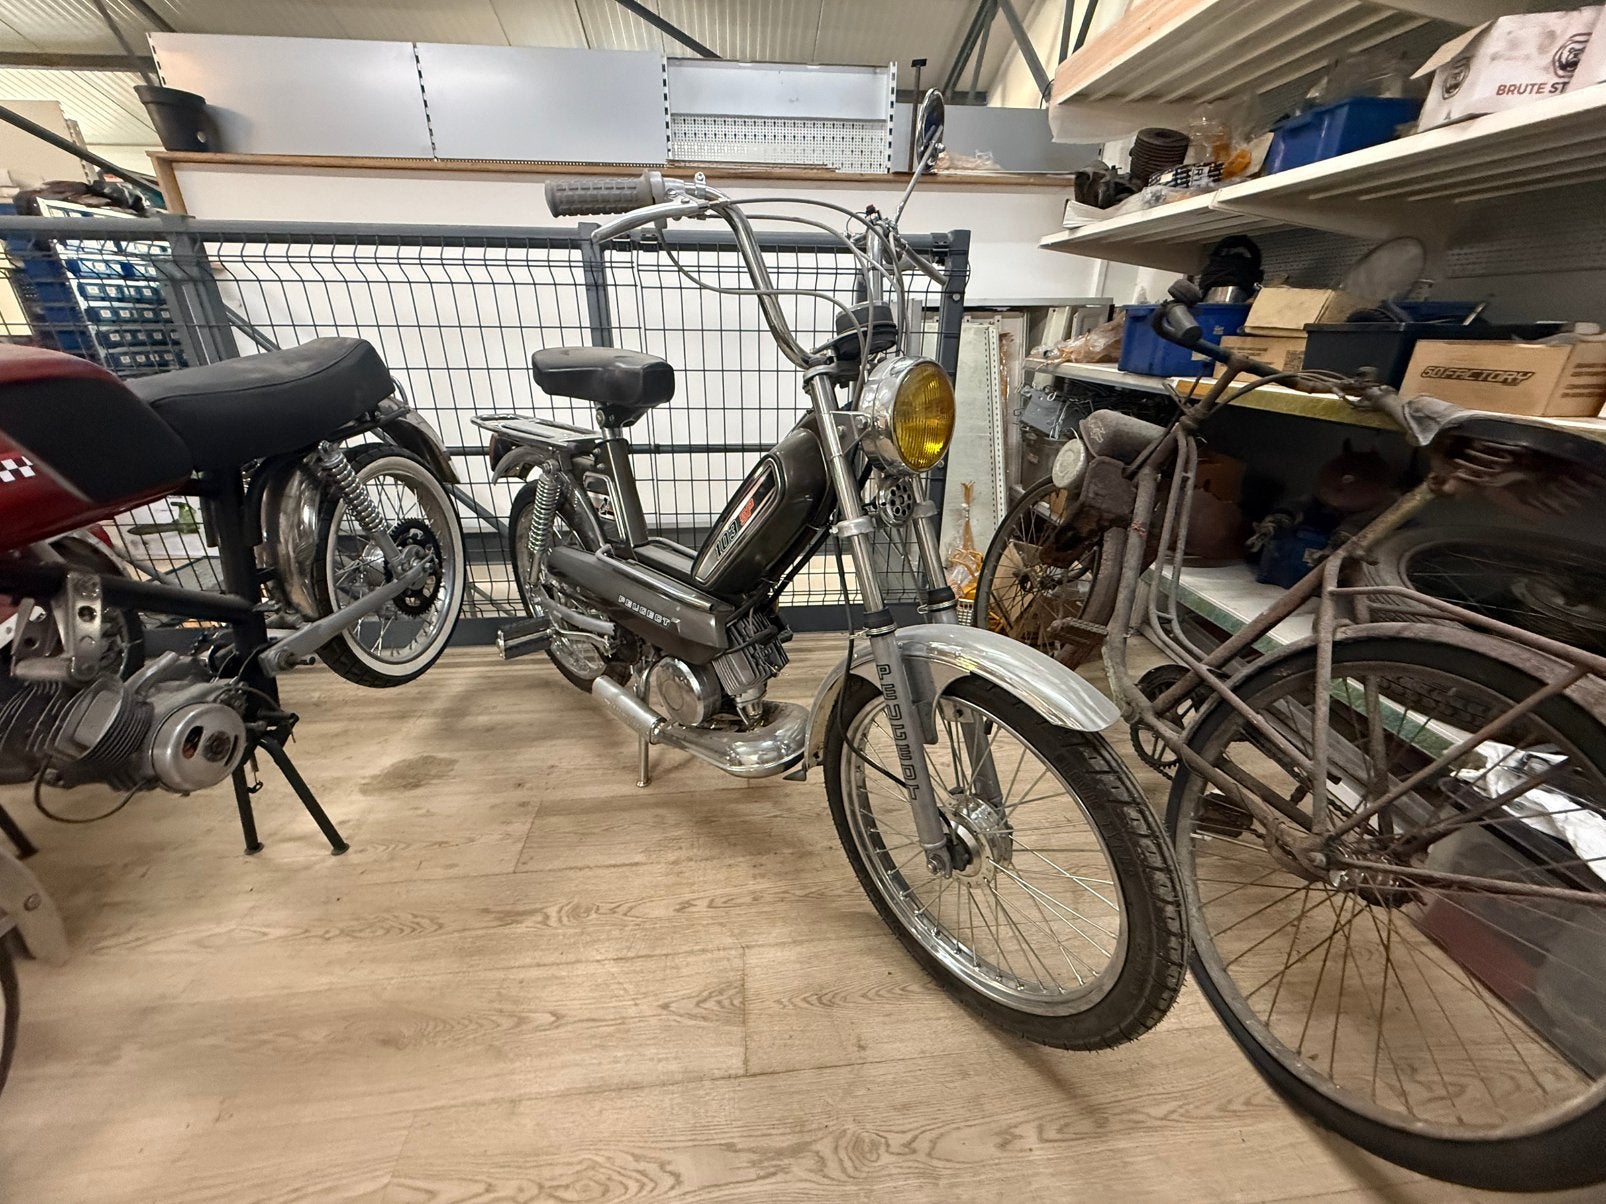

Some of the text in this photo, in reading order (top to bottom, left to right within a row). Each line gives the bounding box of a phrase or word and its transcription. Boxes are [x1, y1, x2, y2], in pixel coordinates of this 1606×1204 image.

[1496, 82, 1547, 96] BRUTE
[714, 519, 739, 560] 103
[618, 595, 670, 627] PEUGEOT
[876, 663, 920, 800] PEUGEOT
